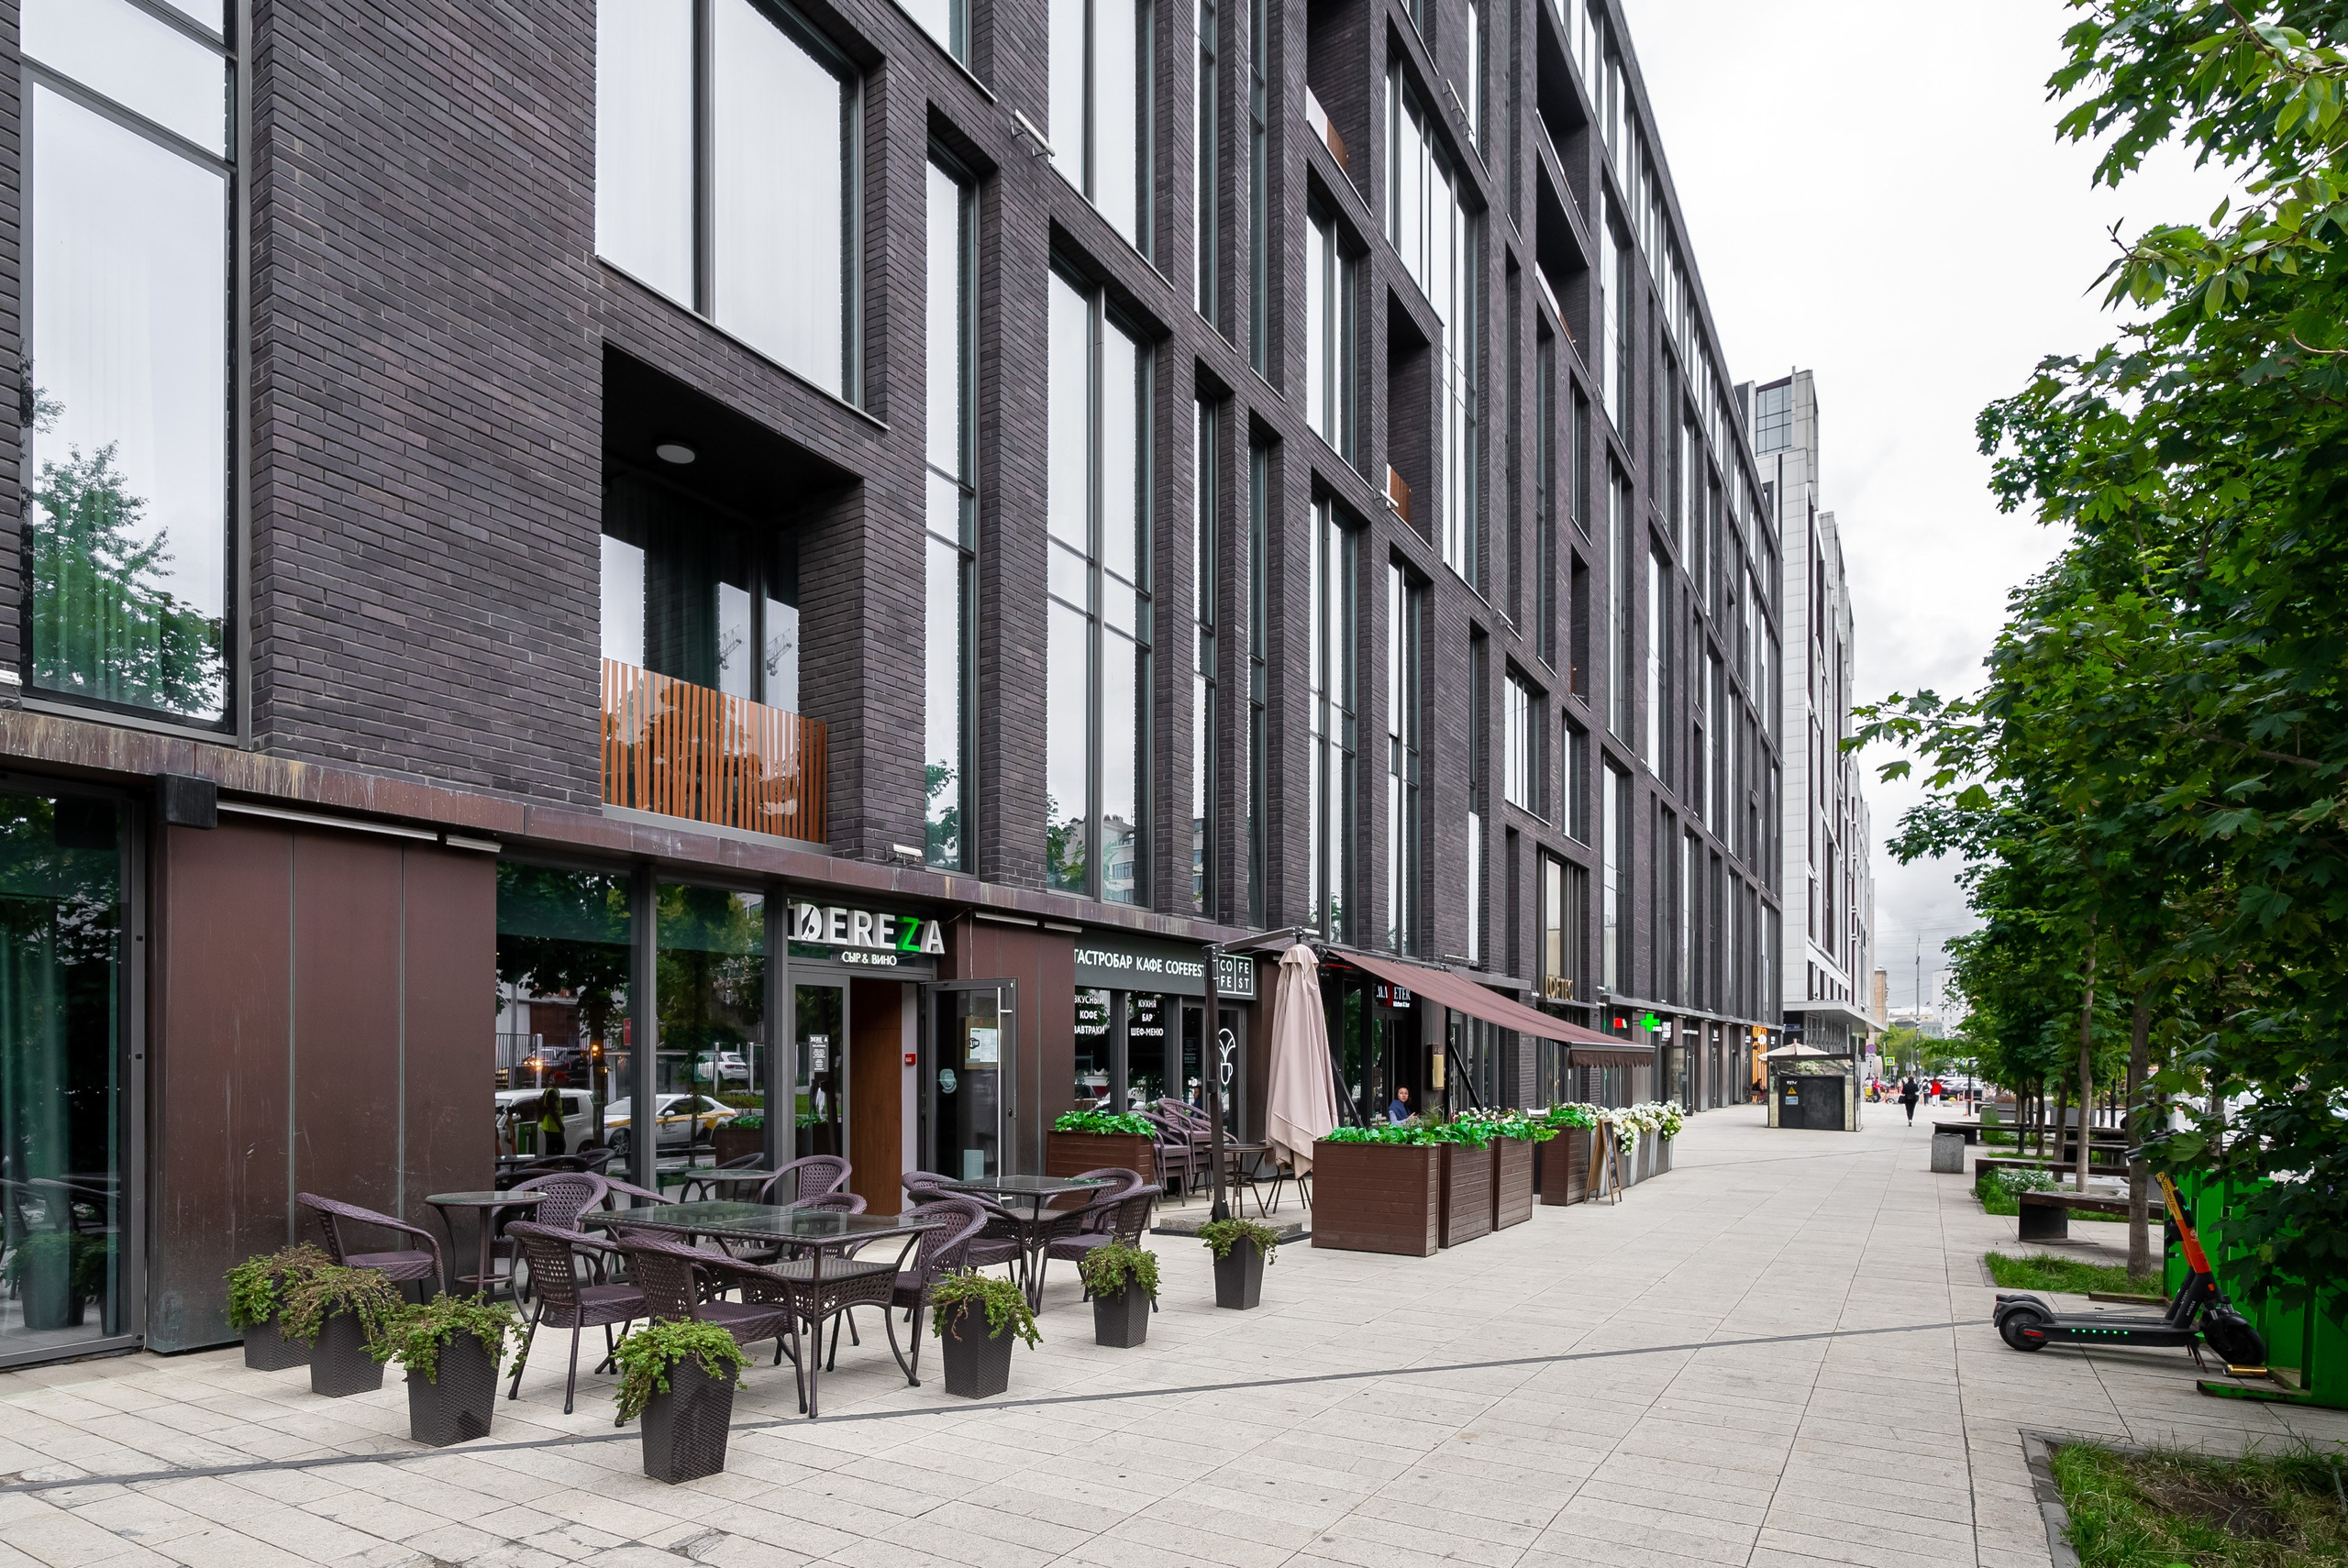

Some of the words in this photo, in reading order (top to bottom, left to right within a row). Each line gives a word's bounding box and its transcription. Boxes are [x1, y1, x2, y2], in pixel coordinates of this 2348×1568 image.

[794, 903, 946, 955] DEREZA
[842, 951, 861, 964] СЫР
[861, 954, 869, 965] &
[871, 955, 897, 966] ВИНО
[1074, 948, 1133, 970] ГАСТРОБАР
[1136, 956, 1163, 973] КАФЕ
[1220, 959, 1233, 972] CO
[1238, 961, 1249, 974] FE
[1220, 975, 1232, 988] FE
[1238, 977, 1249, 989] ST
[1079, 1010, 1098, 1020] КОФЕ
[1142, 1013, 1153, 1022] БАР
[1130, 1027, 1164, 1037] ШЕФ-МЕНЮ
